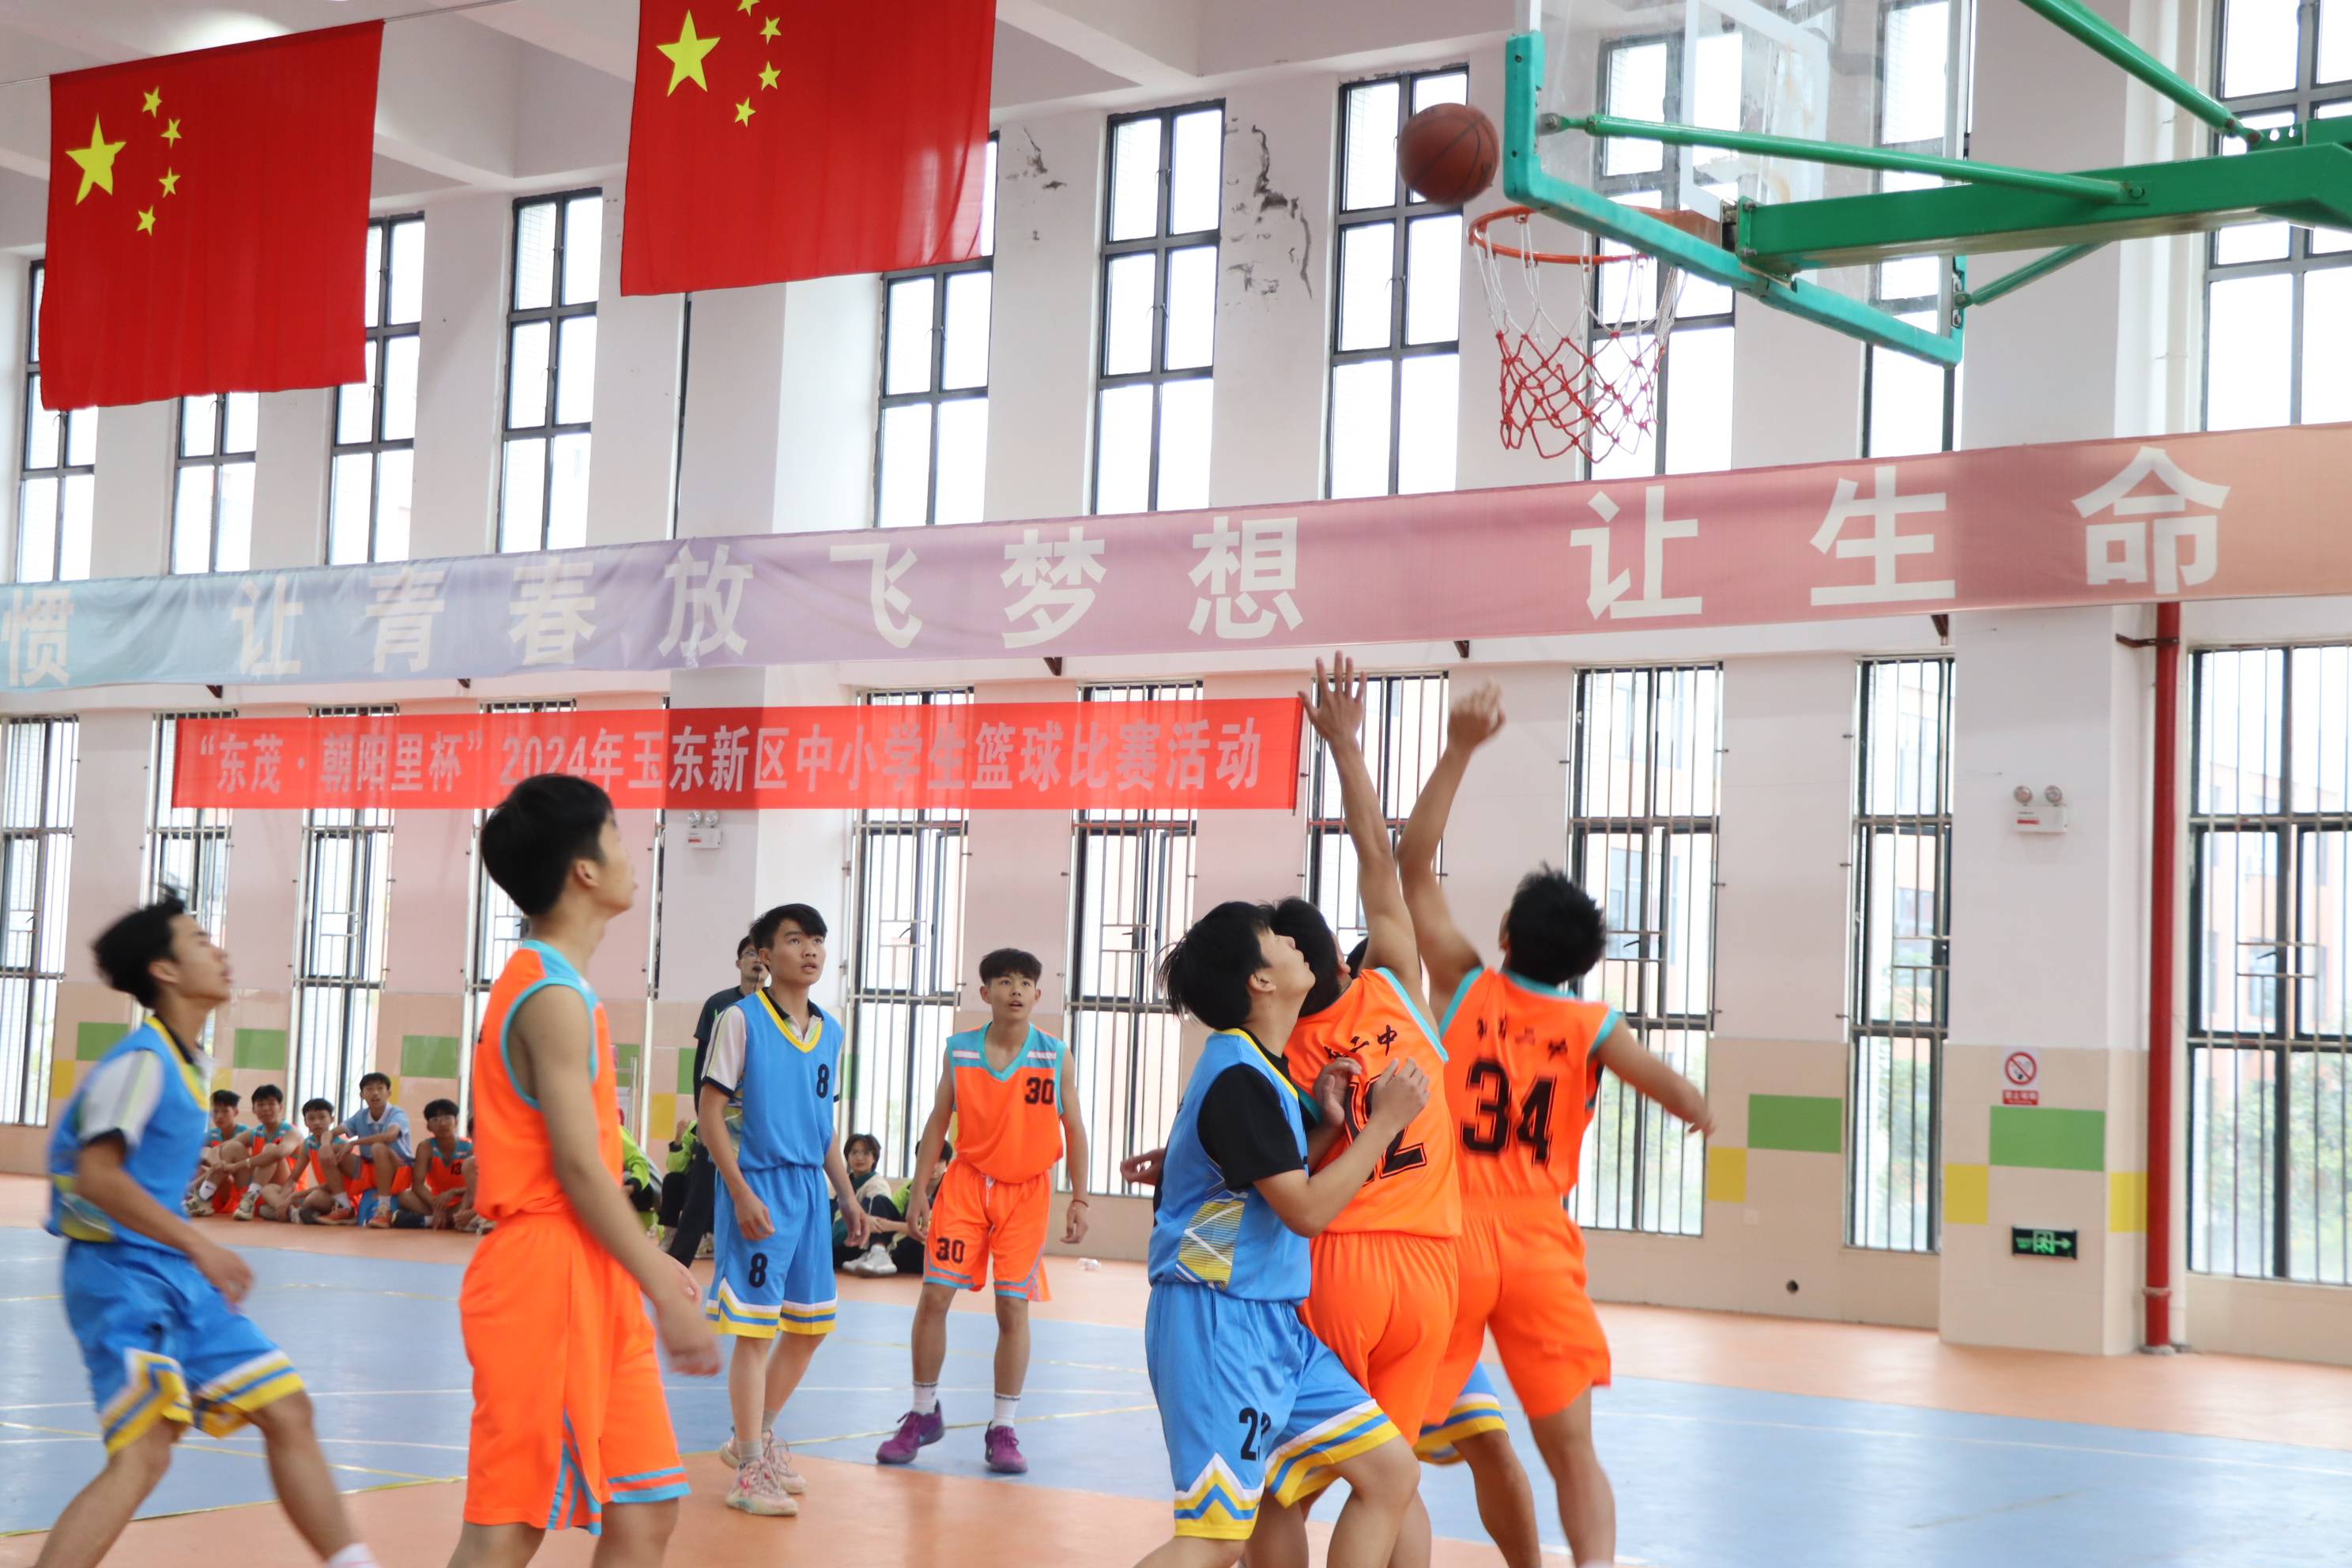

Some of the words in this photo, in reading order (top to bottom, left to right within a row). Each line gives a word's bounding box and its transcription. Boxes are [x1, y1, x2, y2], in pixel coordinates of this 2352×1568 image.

[2, 588, 74, 687] 惯
[816, 1063, 830, 1099] 8
[1025, 1076, 1055, 1106] 30
[1461, 1056, 1557, 1171] 34
[936, 1238, 965, 1264] 30
[748, 1253, 768, 1288] 8
